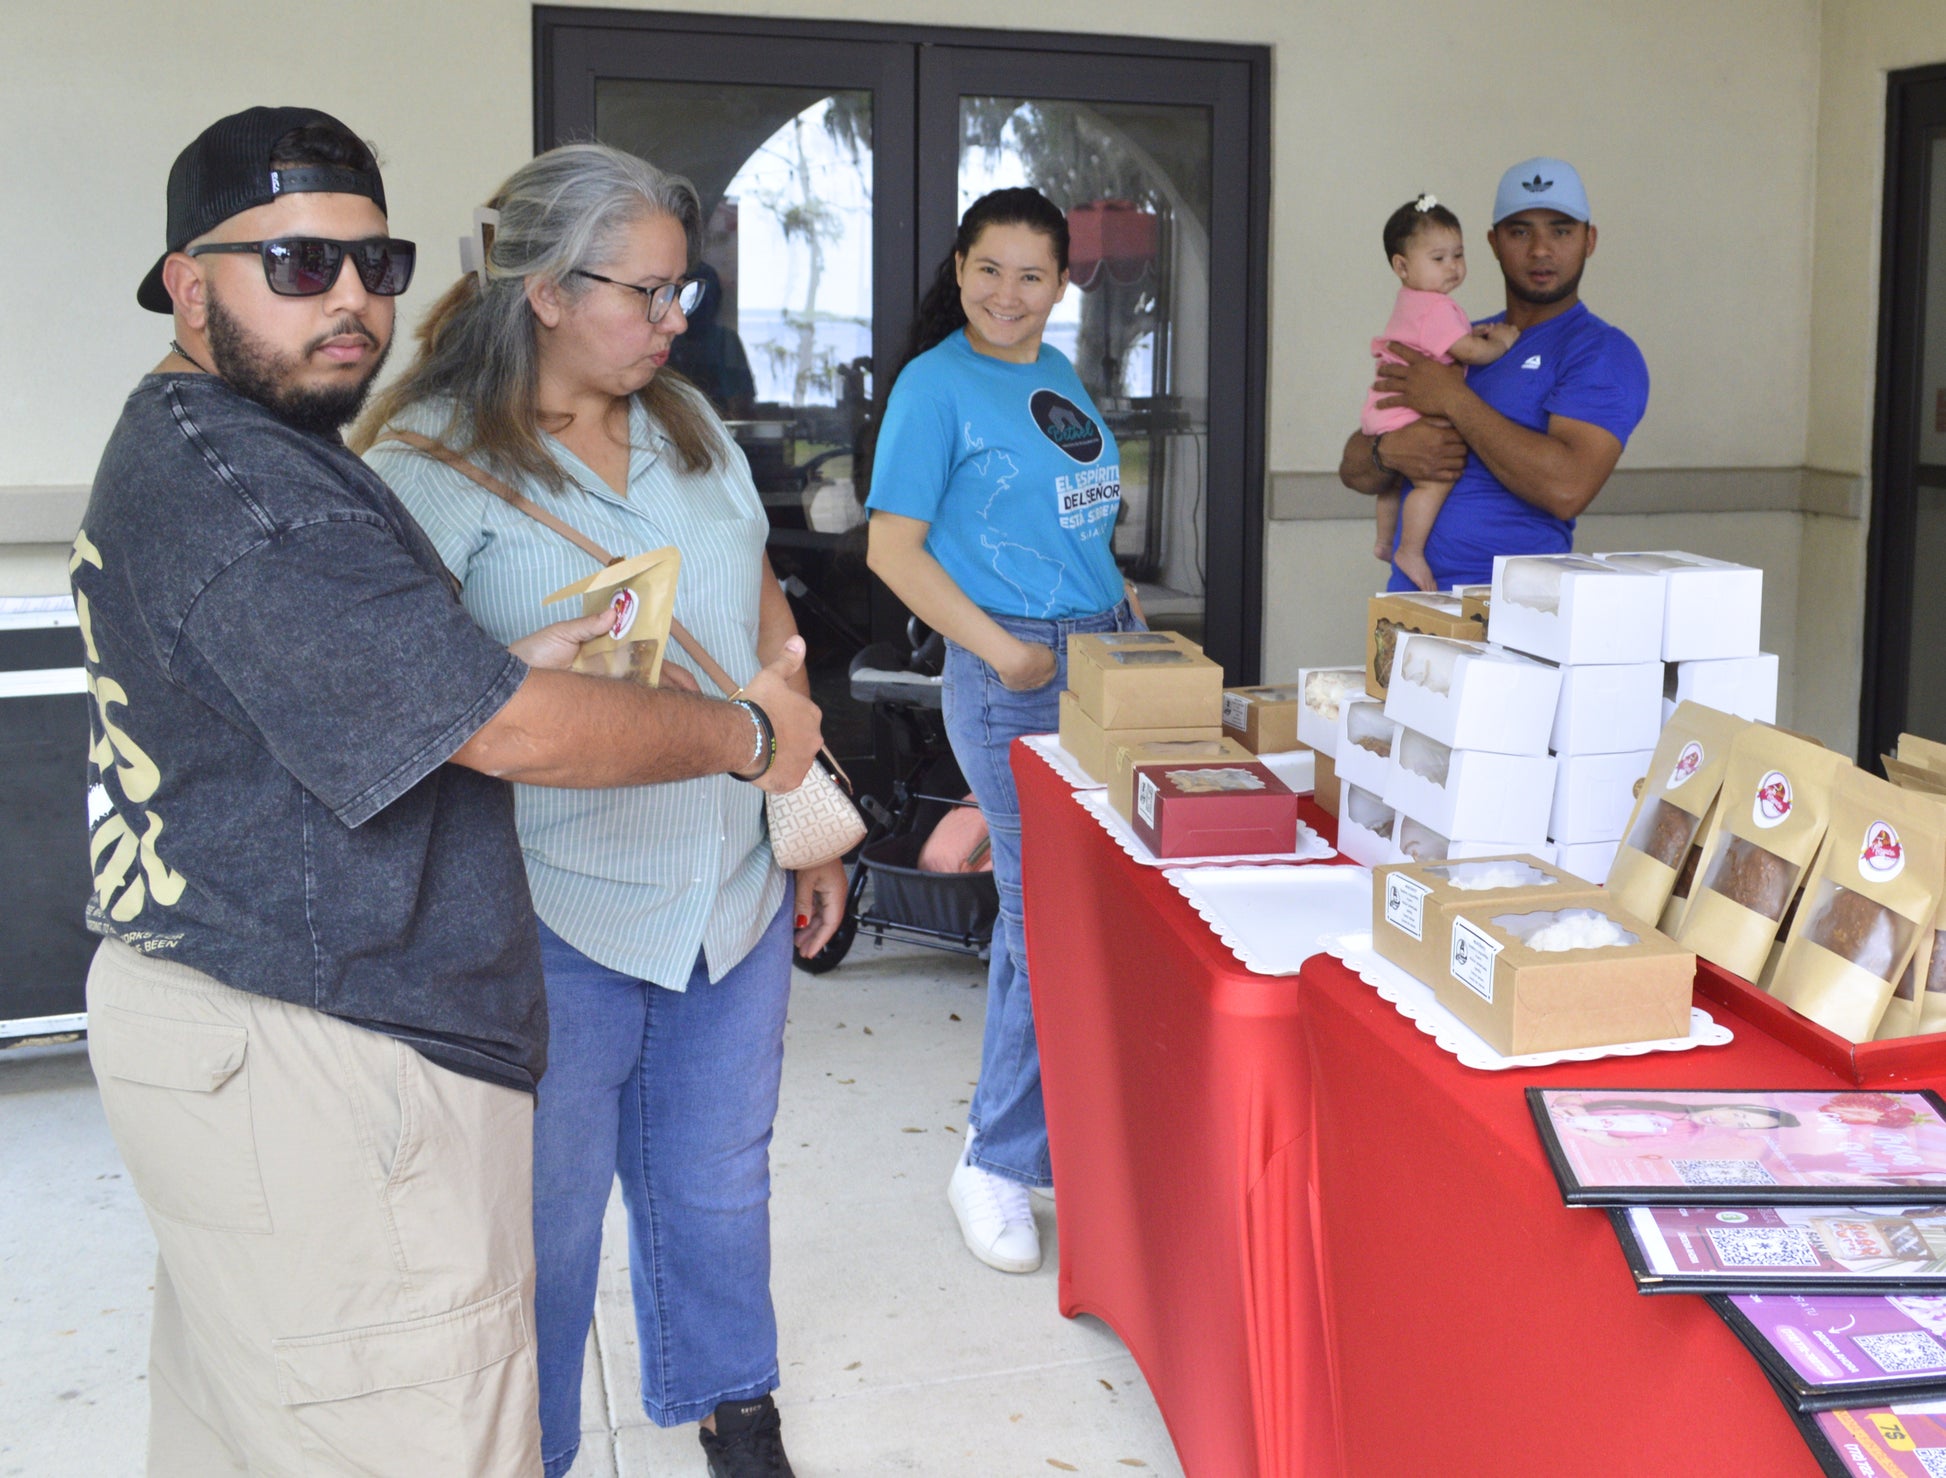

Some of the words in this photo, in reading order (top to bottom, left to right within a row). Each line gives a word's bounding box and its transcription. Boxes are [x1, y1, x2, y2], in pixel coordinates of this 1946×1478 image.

[1055, 476, 1073, 493] EL
[1064, 492, 1087, 510] DEL
[1086, 483, 1120, 504] SEÑOR
[144, 939, 179, 952] BEEN
[1880, 1424, 1906, 1440] 7$
